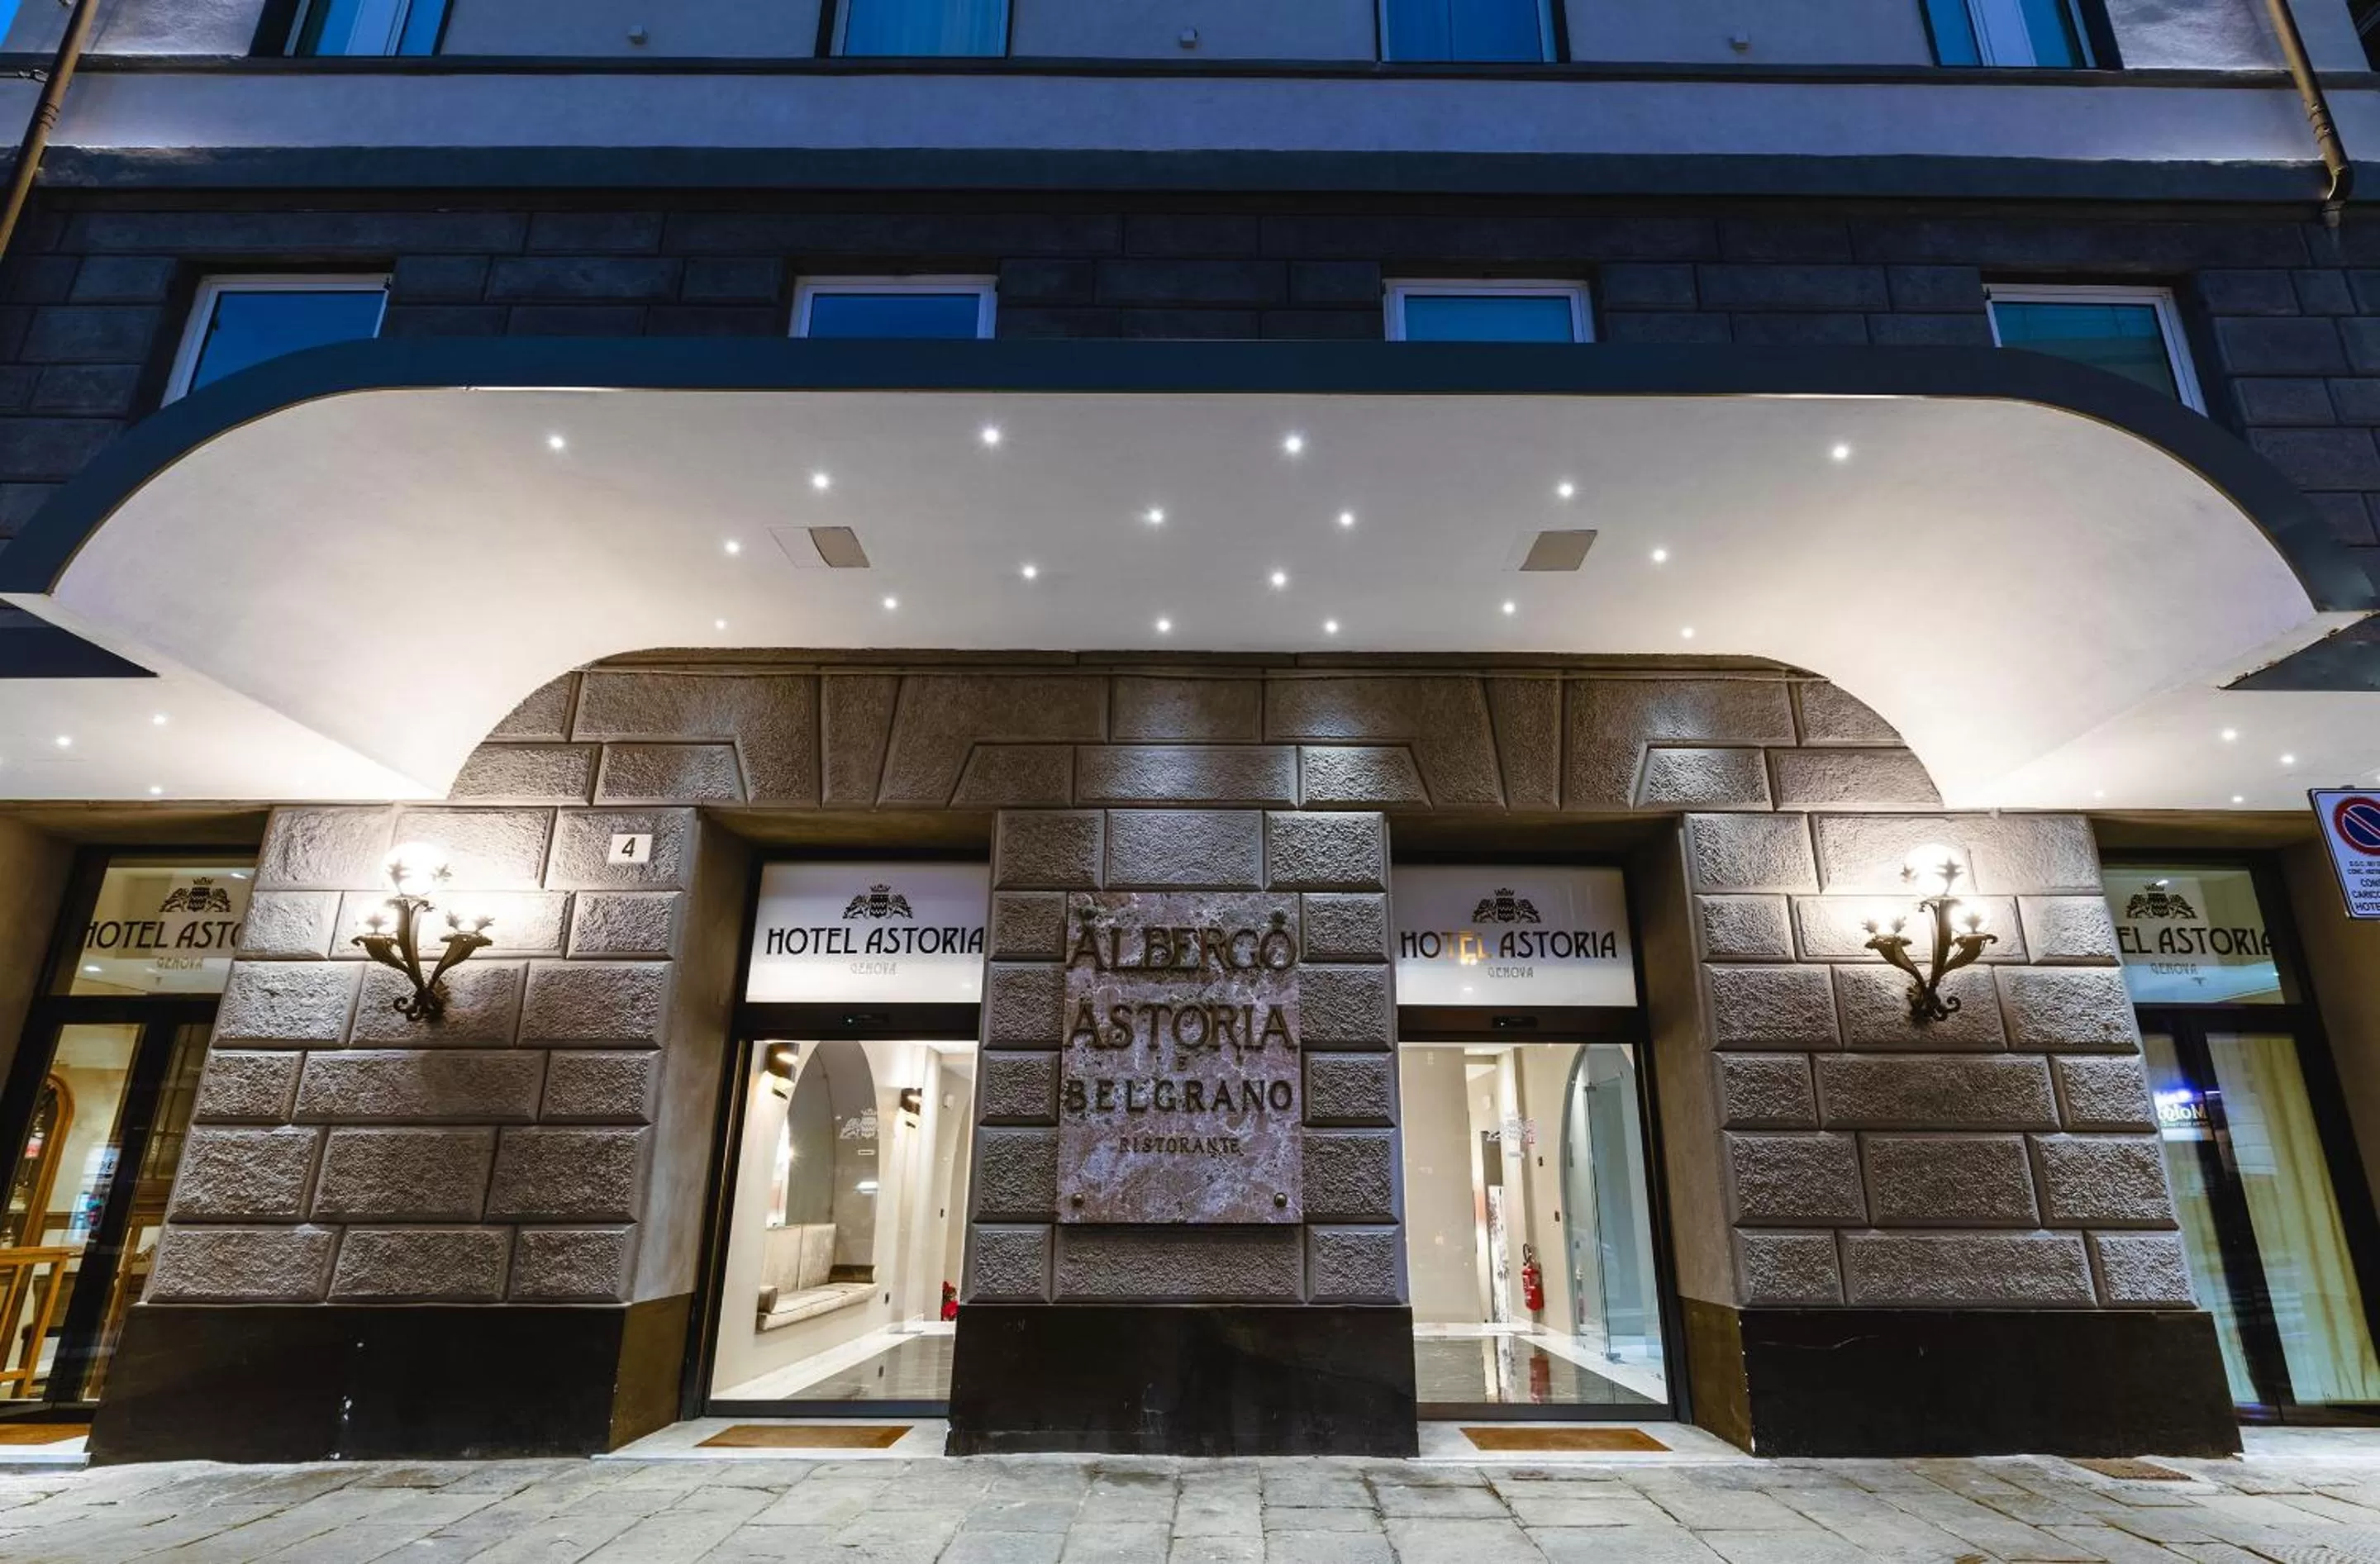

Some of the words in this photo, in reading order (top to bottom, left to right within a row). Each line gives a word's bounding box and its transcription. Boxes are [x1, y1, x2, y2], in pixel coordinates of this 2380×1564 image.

[621, 837, 635, 857] 4
[766, 928, 857, 955] HOTEL
[864, 927, 984, 954] ASTORIA
[1068, 925, 1299, 971] ALBERGO
[1400, 931, 1493, 959] HOTEL
[1499, 931, 1617, 958] ASTORIA
[2159, 927, 2273, 955] ASTORIA
[1067, 1003, 1298, 1050] ASTORIA
[1064, 1079, 1293, 1112] BELGRANO
[1119, 1137, 1242, 1155] RISTORANTE
